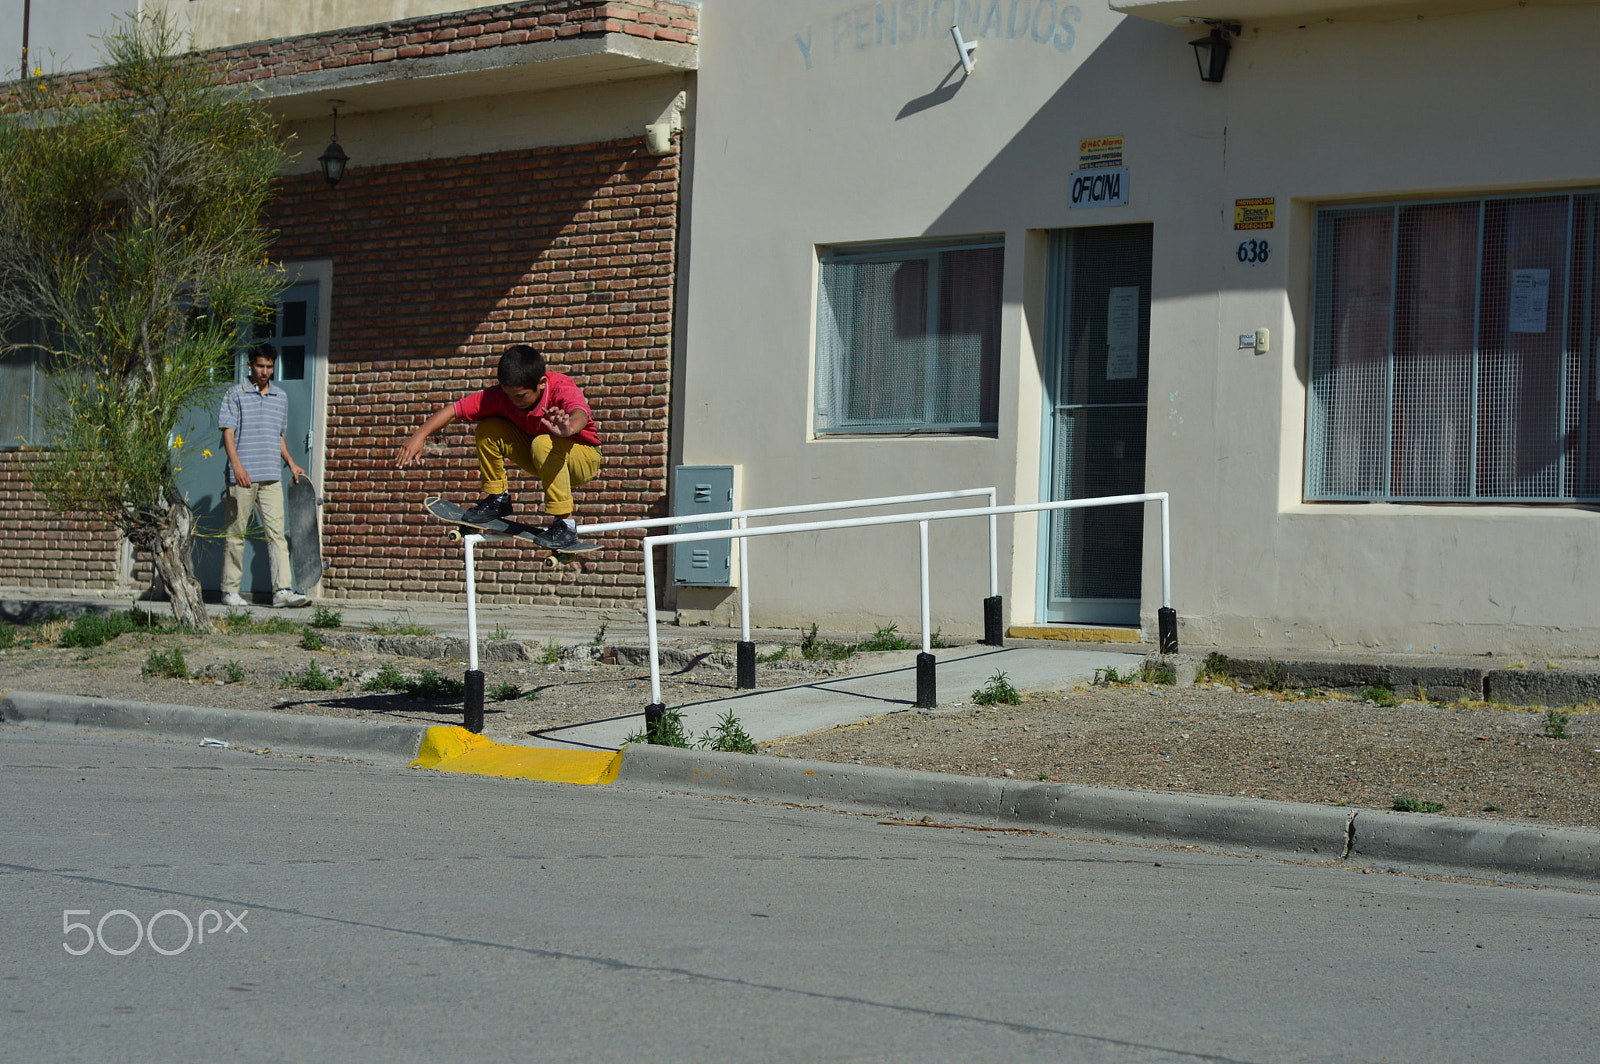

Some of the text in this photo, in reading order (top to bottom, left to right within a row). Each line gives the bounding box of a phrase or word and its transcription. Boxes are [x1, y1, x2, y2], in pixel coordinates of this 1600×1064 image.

[793, 0, 1082, 70] Y PENSIONADOS
[1072, 173, 1120, 204] OFICINA
[1240, 207, 1269, 216] TECNICA
[1238, 240, 1268, 263] 638
